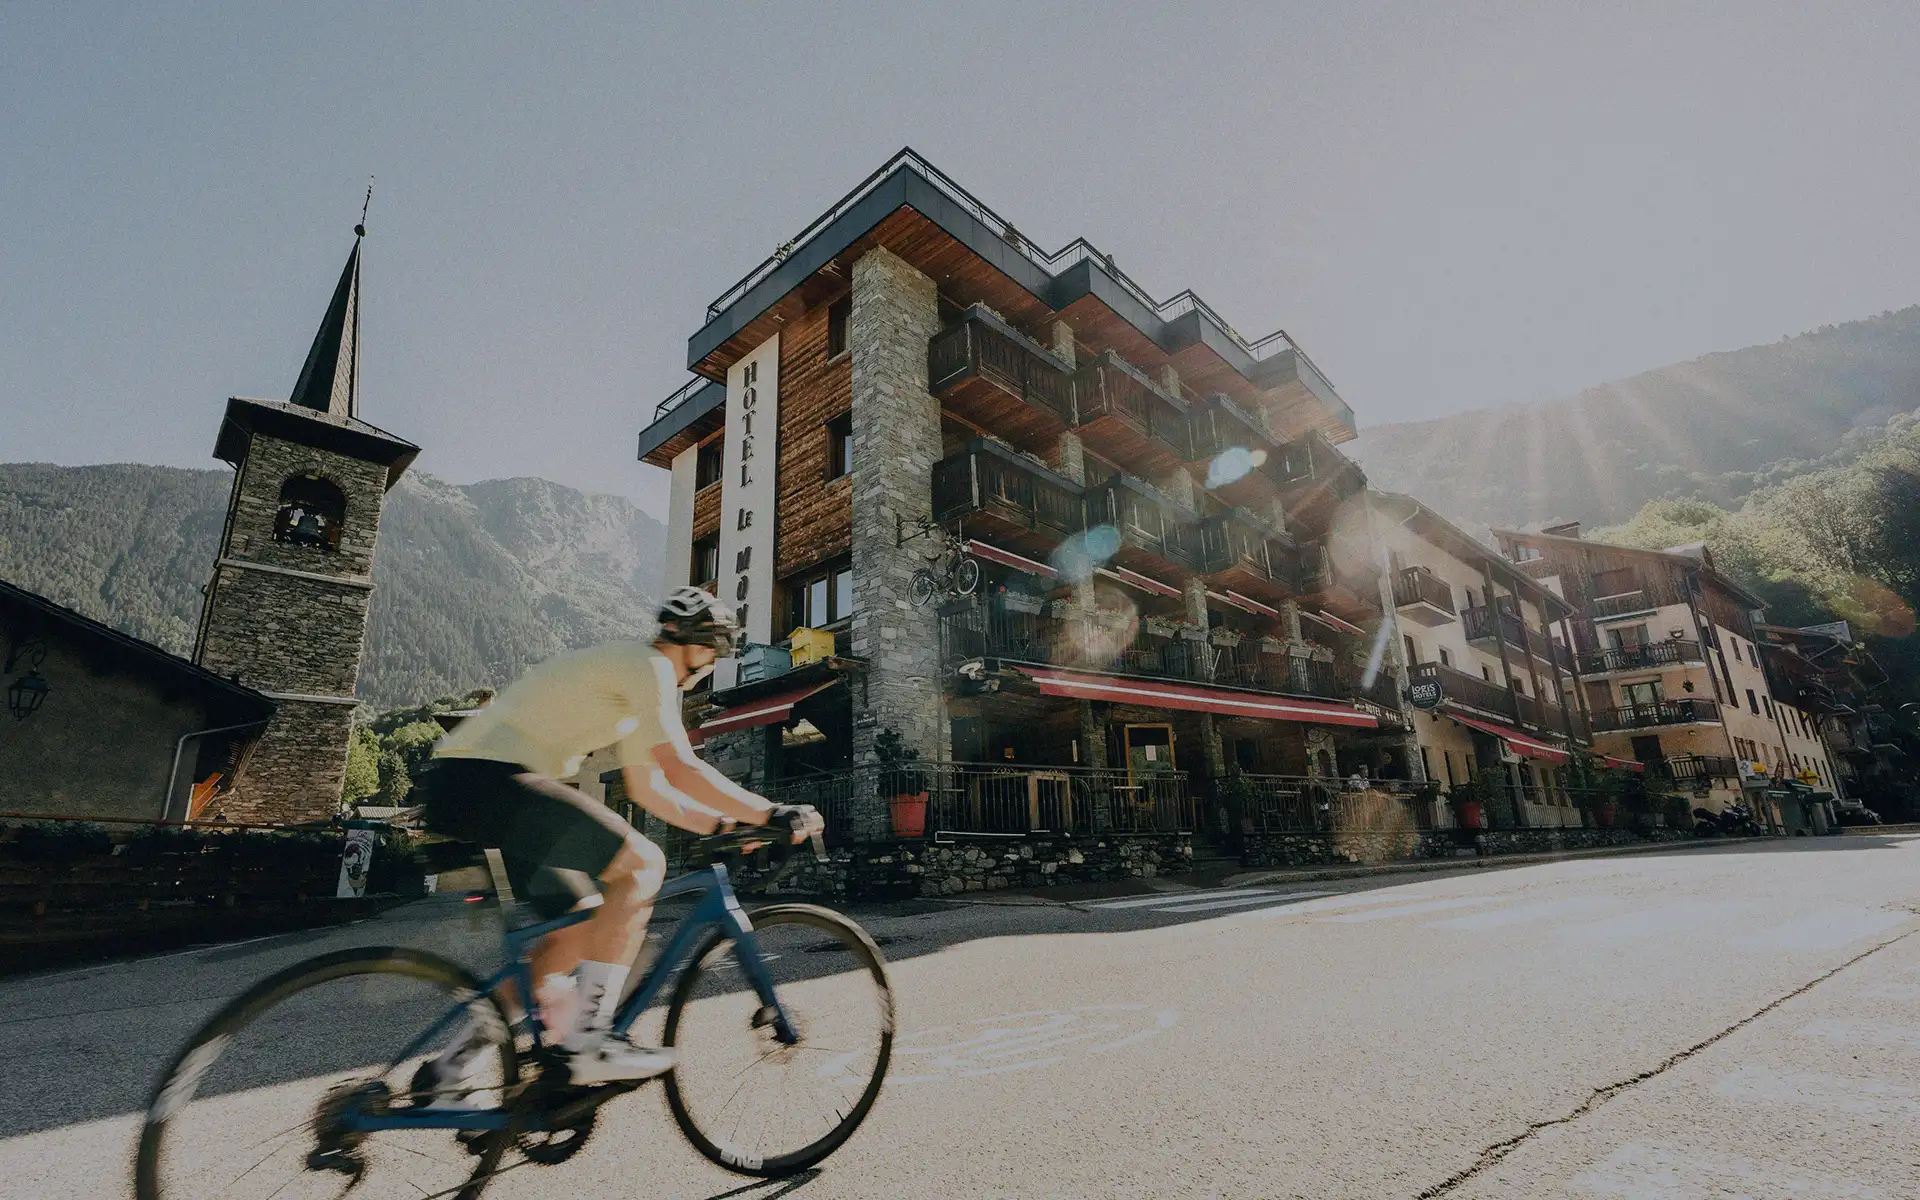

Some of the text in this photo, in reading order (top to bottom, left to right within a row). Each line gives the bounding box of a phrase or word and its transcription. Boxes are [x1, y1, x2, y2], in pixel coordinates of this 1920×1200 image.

[740, 361, 757, 488] HOTEL
[1413, 691, 1437, 700] HOTELS
[1365, 703, 1382, 716] HOTEL
